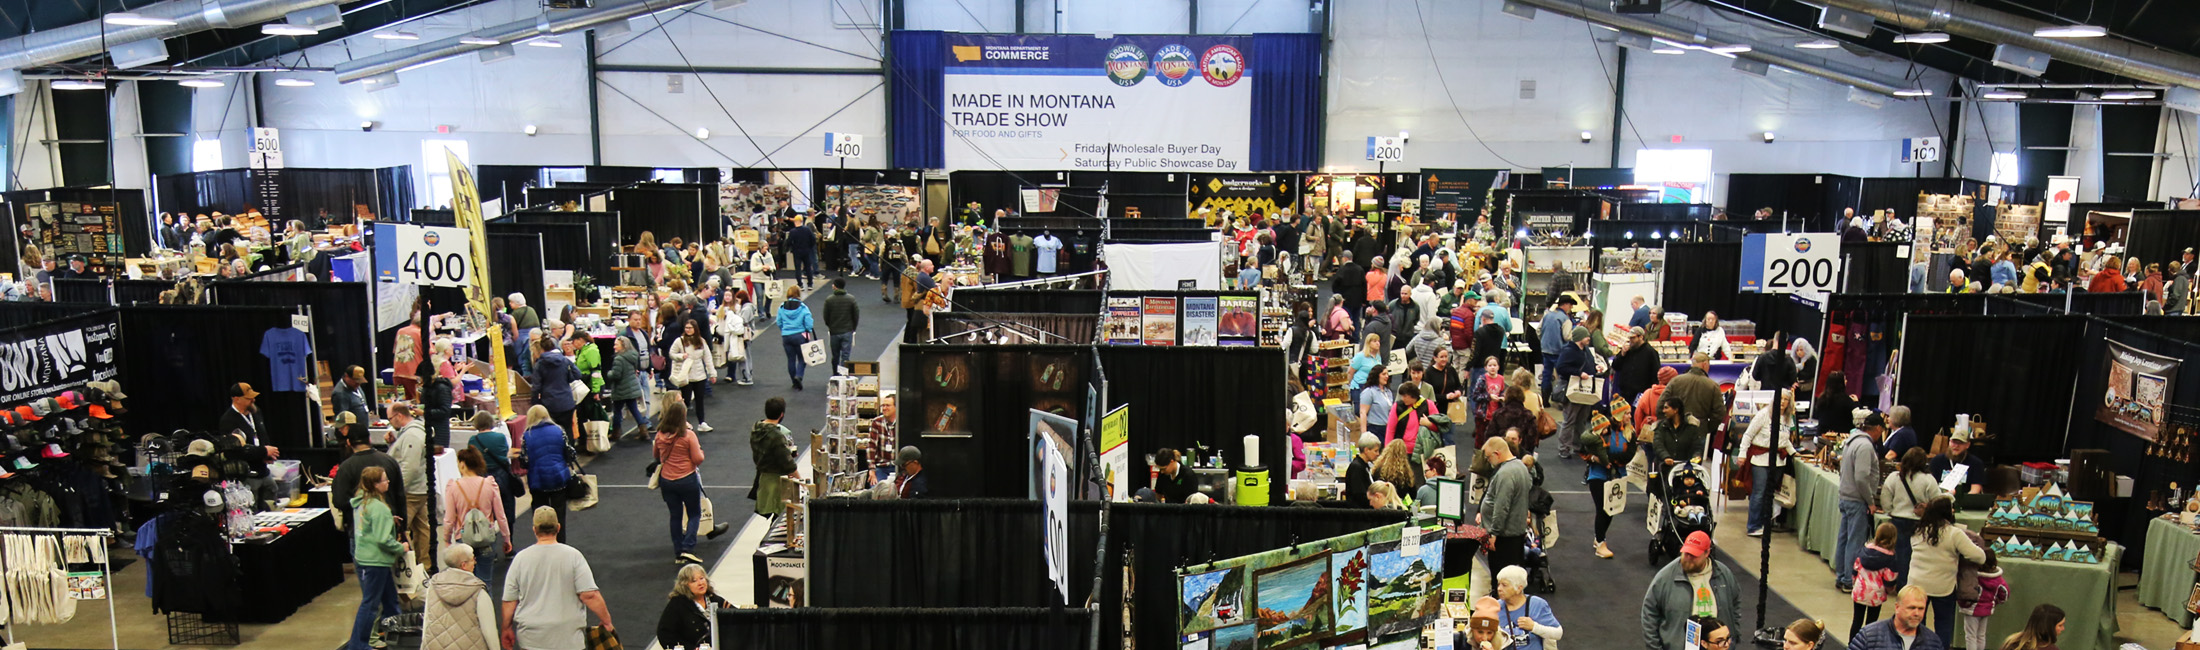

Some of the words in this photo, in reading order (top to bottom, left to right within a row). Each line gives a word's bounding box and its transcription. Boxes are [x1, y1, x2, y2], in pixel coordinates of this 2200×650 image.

[985, 51, 1049, 60] COMMERCE
[1109, 45, 1135, 60] GROWN
[1136, 48, 1145, 60] IN
[1158, 45, 1181, 58] MADE
[1182, 47, 1192, 58] IN
[1203, 54, 1212, 73] NATIVE
[1211, 47, 1236, 57] AMERICAN
[1106, 61, 1149, 76] MONTANA
[1154, 61, 1197, 76] MONTANA
[1119, 79, 1135, 87] USA
[1167, 79, 1182, 87] USA
[952, 94, 1002, 107] MADE
[1008, 95, 1024, 108] IN
[1030, 95, 1115, 109] MONTANA
[952, 112, 1009, 126] TRADE
[1014, 113, 1068, 127] SHOW
[257, 138, 278, 151] 500
[835, 143, 860, 156] 400
[1074, 144, 1107, 154] Friday
[1109, 144, 1164, 153] Wholesale
[1167, 145, 1198, 155] Buyer
[1201, 145, 1221, 155] Day
[1376, 146, 1401, 160] 200
[1913, 147, 1936, 160] 100
[1074, 158, 1121, 168] Saturday
[1124, 158, 1157, 168] Public
[1160, 159, 1214, 168] Showcase
[1216, 159, 1237, 170] Day
[404, 251, 465, 282] 400
[1768, 258, 1832, 287] 200
[38, 336, 52, 384] MONTANA
[1, 394, 12, 404] OUR
[12, 390, 30, 400] ONLINE
[1402, 534, 1411, 547] 226
[1411, 534, 1420, 546] 227
